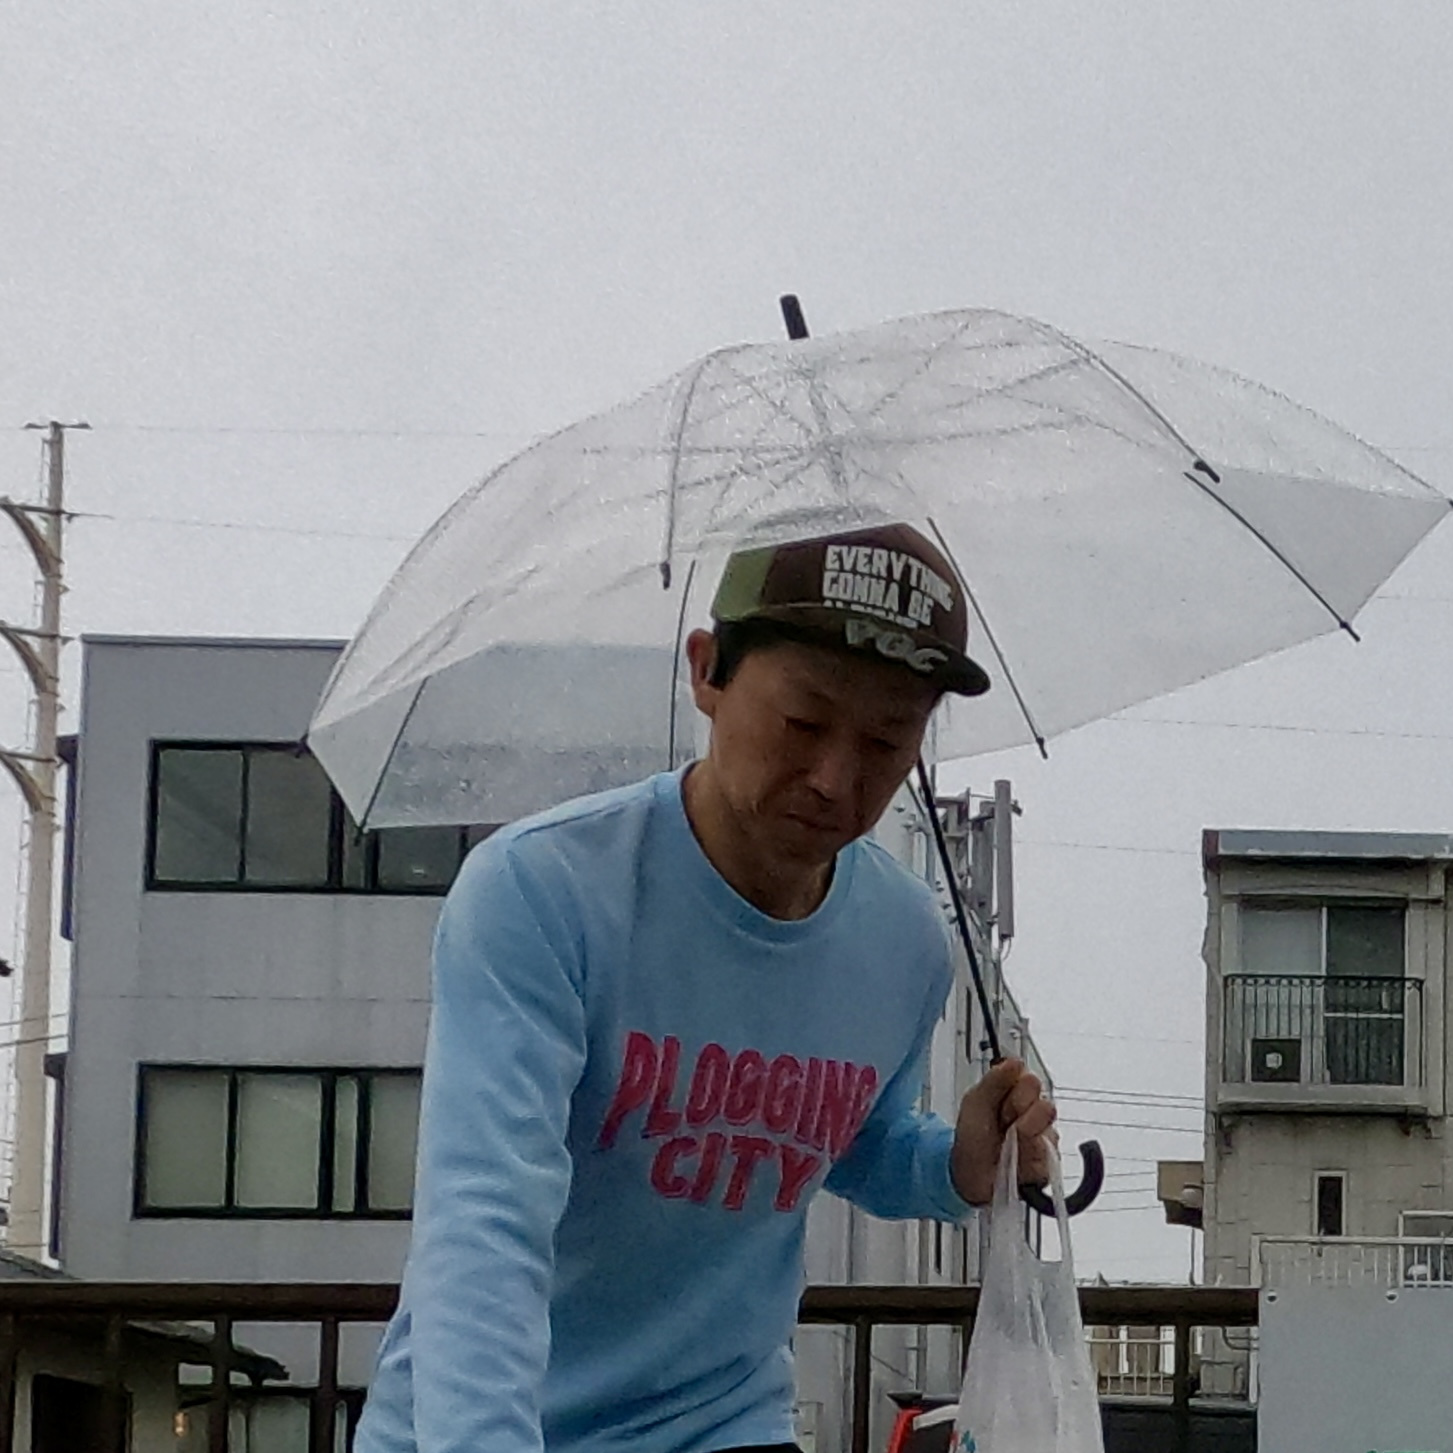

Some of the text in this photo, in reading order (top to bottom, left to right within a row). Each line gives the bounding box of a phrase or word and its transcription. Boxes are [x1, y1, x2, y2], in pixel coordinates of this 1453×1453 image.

[822, 570, 900, 614] GONNA
[907, 589, 935, 627] BE
[650, 1131, 823, 1213] CITY
